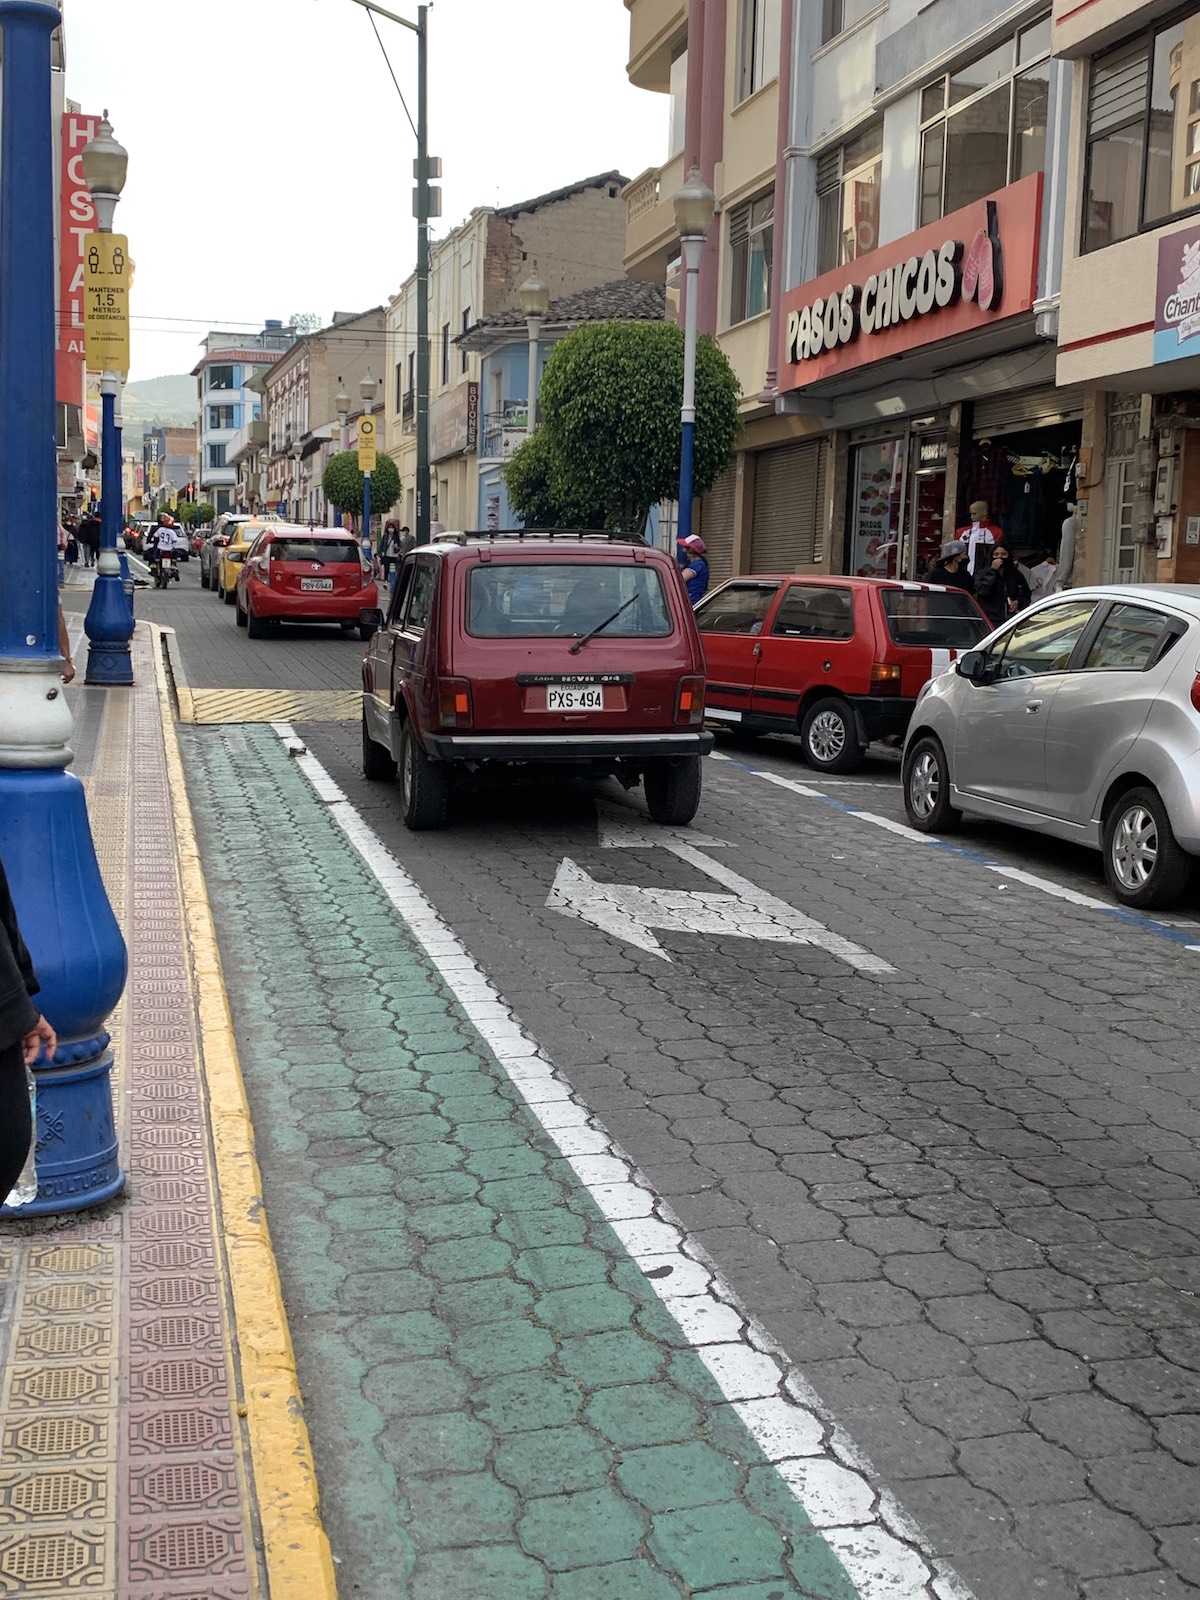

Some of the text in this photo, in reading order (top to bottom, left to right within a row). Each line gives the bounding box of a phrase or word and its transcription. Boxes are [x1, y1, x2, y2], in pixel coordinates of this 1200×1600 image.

[95, 293, 115, 306] 1.5
[785, 239, 959, 365] PASOS CHICOS
[468, 387, 477, 443] BOTONES
[549, 692, 602, 708] PXS-494
